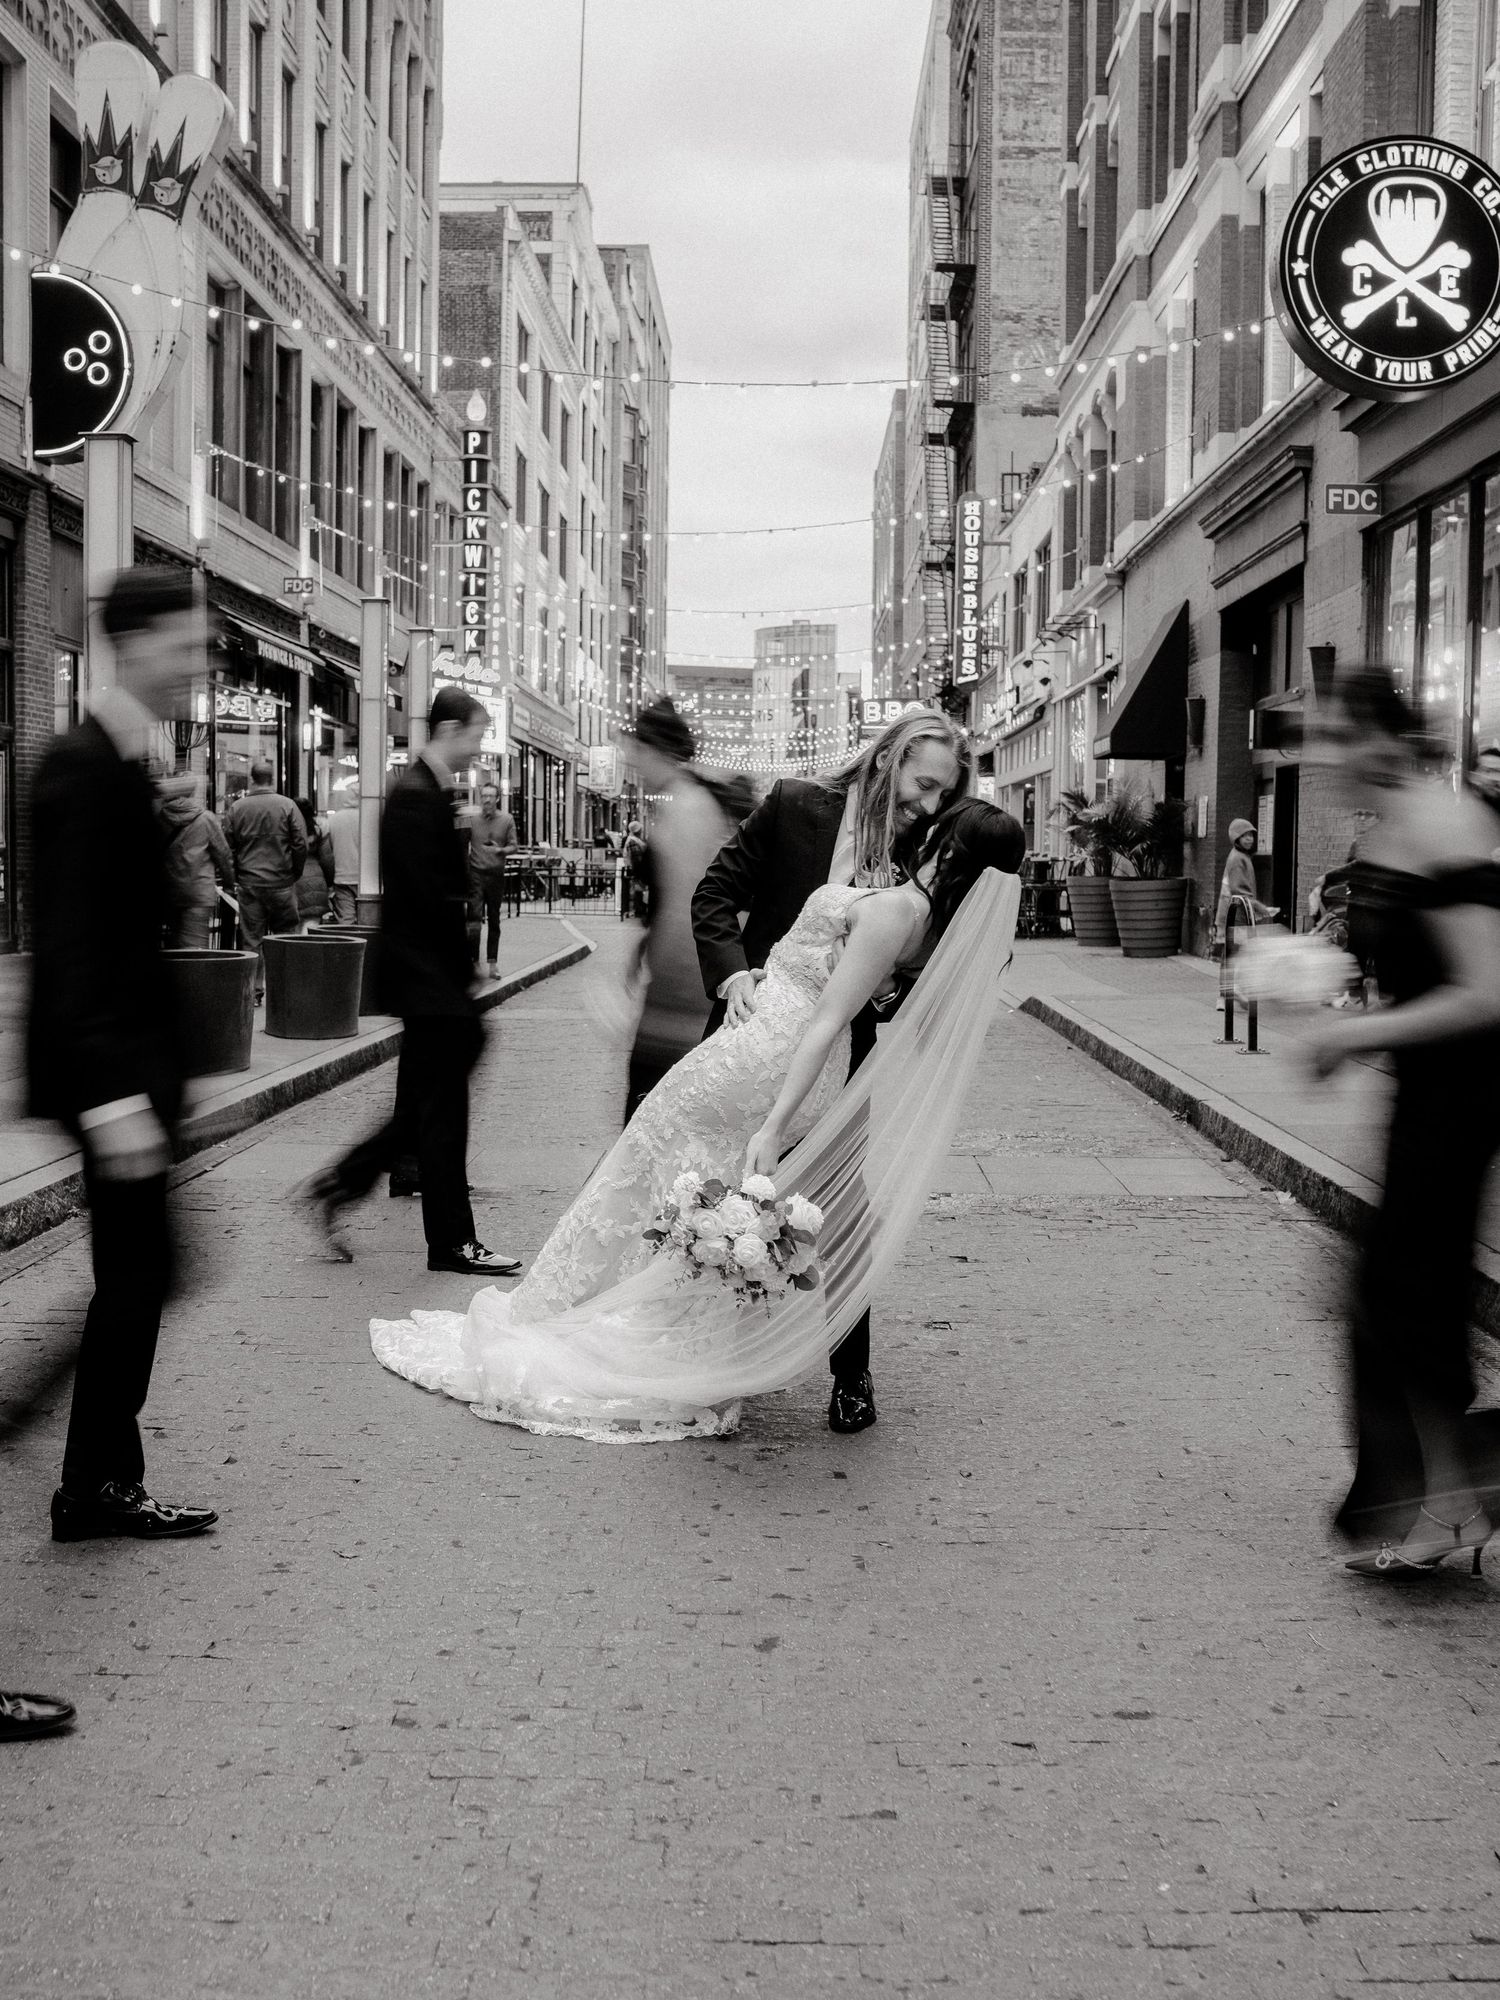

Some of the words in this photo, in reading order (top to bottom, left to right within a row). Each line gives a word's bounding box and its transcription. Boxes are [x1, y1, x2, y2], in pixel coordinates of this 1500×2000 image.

[1309, 167, 1351, 209] CLE
[1355, 145, 1469, 181] CLOTHING
[1472, 176, 1500, 217] CO.
[1309, 315, 1364, 370] WEAR
[1375, 356, 1434, 382] YOUR
[1443, 317, 1500, 373] PRIDE
[1328, 488, 1378, 511] FDC
[464, 431, 483, 652] PICKWICK
[963, 500, 981, 580] HOUSE
[284, 579, 313, 593] FDC
[961, 593, 978, 676] BLUES
